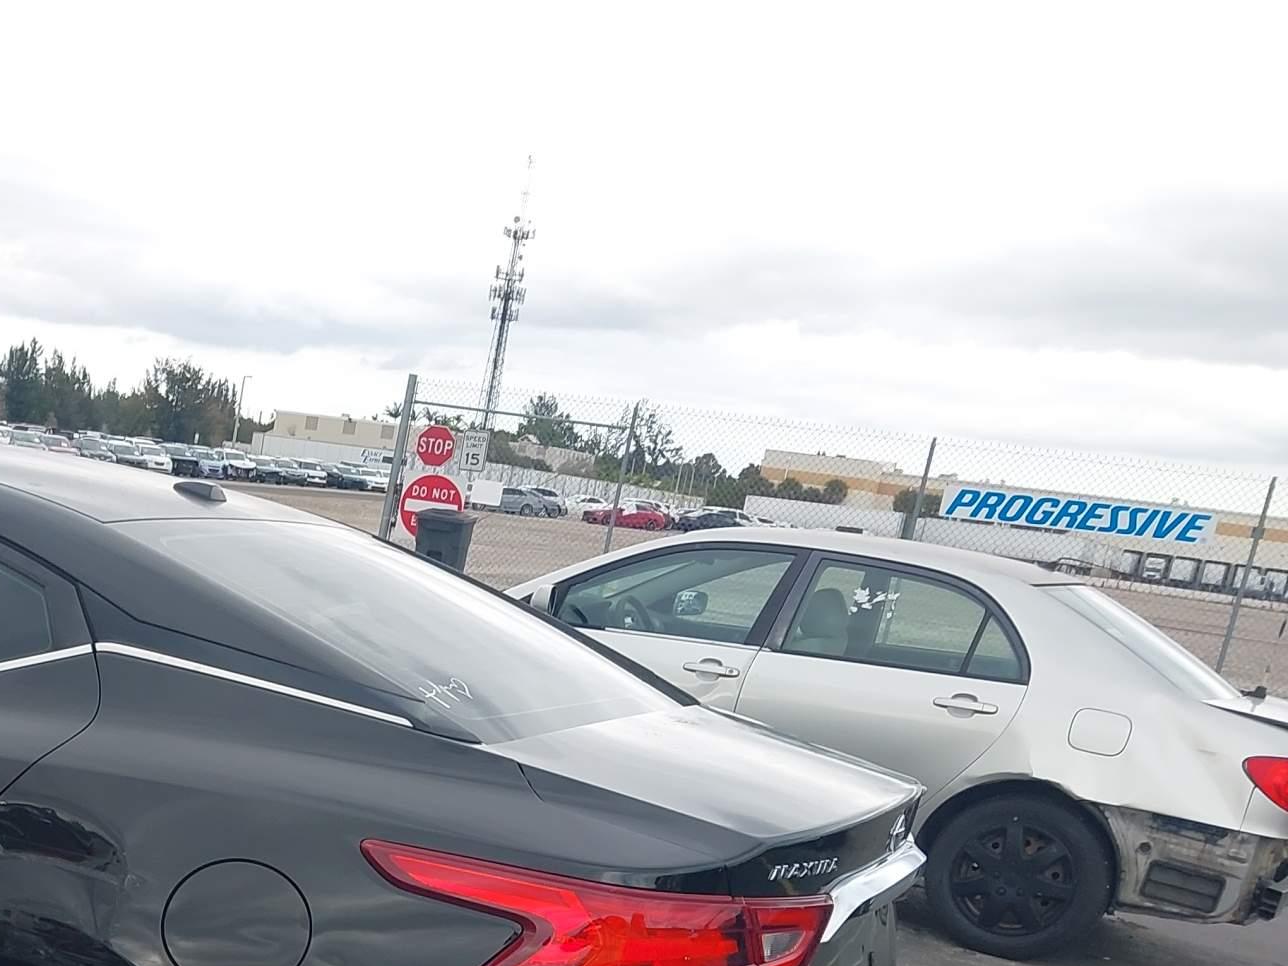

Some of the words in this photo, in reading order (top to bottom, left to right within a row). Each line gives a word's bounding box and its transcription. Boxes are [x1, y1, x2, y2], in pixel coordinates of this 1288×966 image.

[418, 437, 454, 456] STOP
[465, 435, 487, 443] SPEED
[465, 452, 481, 466] 15
[412, 485, 427, 498] DO
[431, 488, 457, 501] NOT
[945, 488, 1213, 543] PROGRESSIVE
[768, 857, 839, 881] MAXIMA
